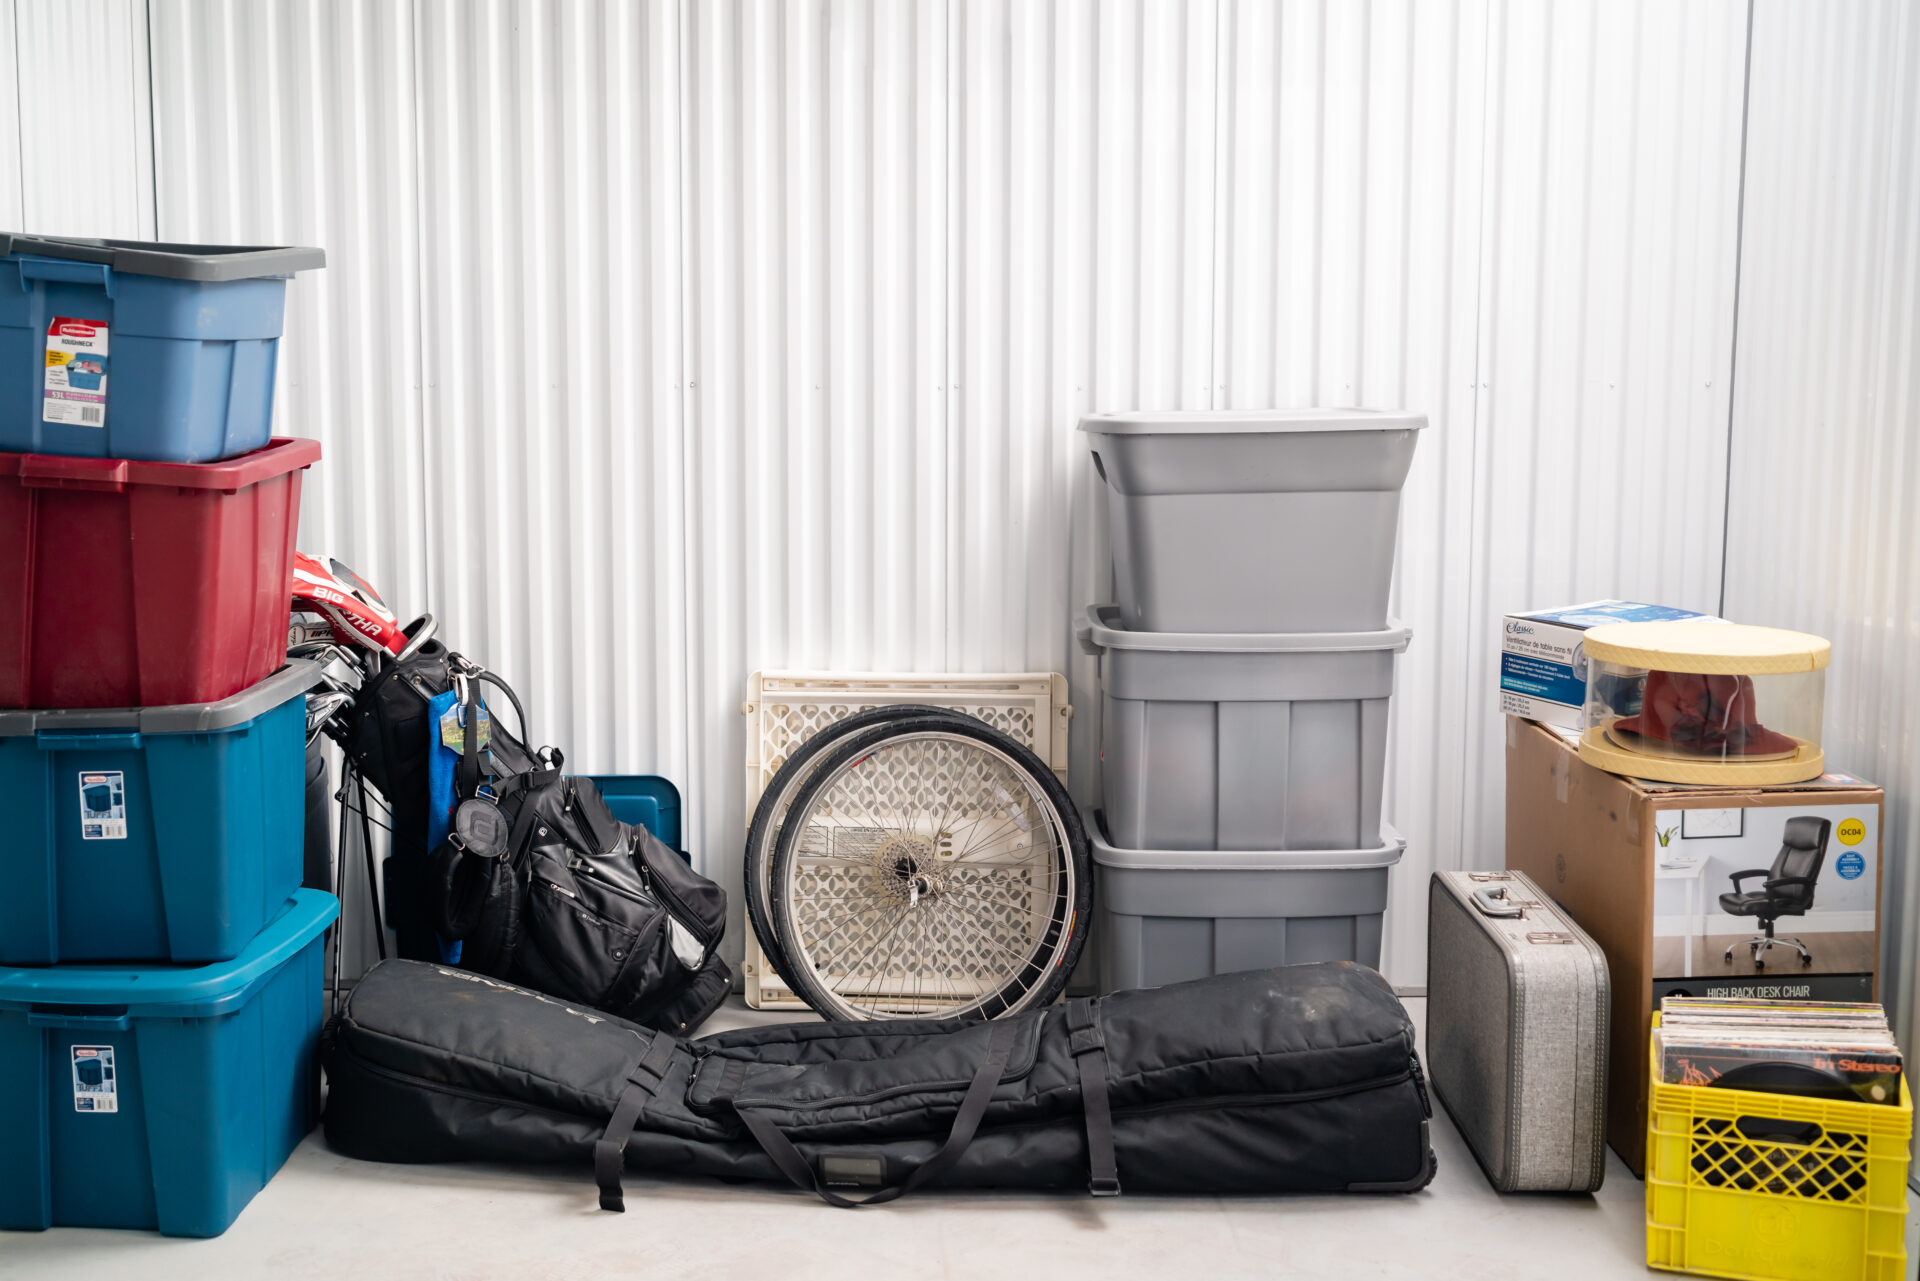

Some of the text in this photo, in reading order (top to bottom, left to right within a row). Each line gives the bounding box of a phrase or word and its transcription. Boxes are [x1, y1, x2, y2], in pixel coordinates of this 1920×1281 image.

[312, 587, 344, 604] BIG
[1506, 621, 1535, 635] Classic
[1506, 635, 1532, 647] Ventilateur
[1540, 642, 1553, 651] table
[1553, 646, 1566, 654] sans
[1707, 985, 1810, 998] HIGH BACK DESK CHAIR
[1813, 1057, 1902, 1074] In Stereo
